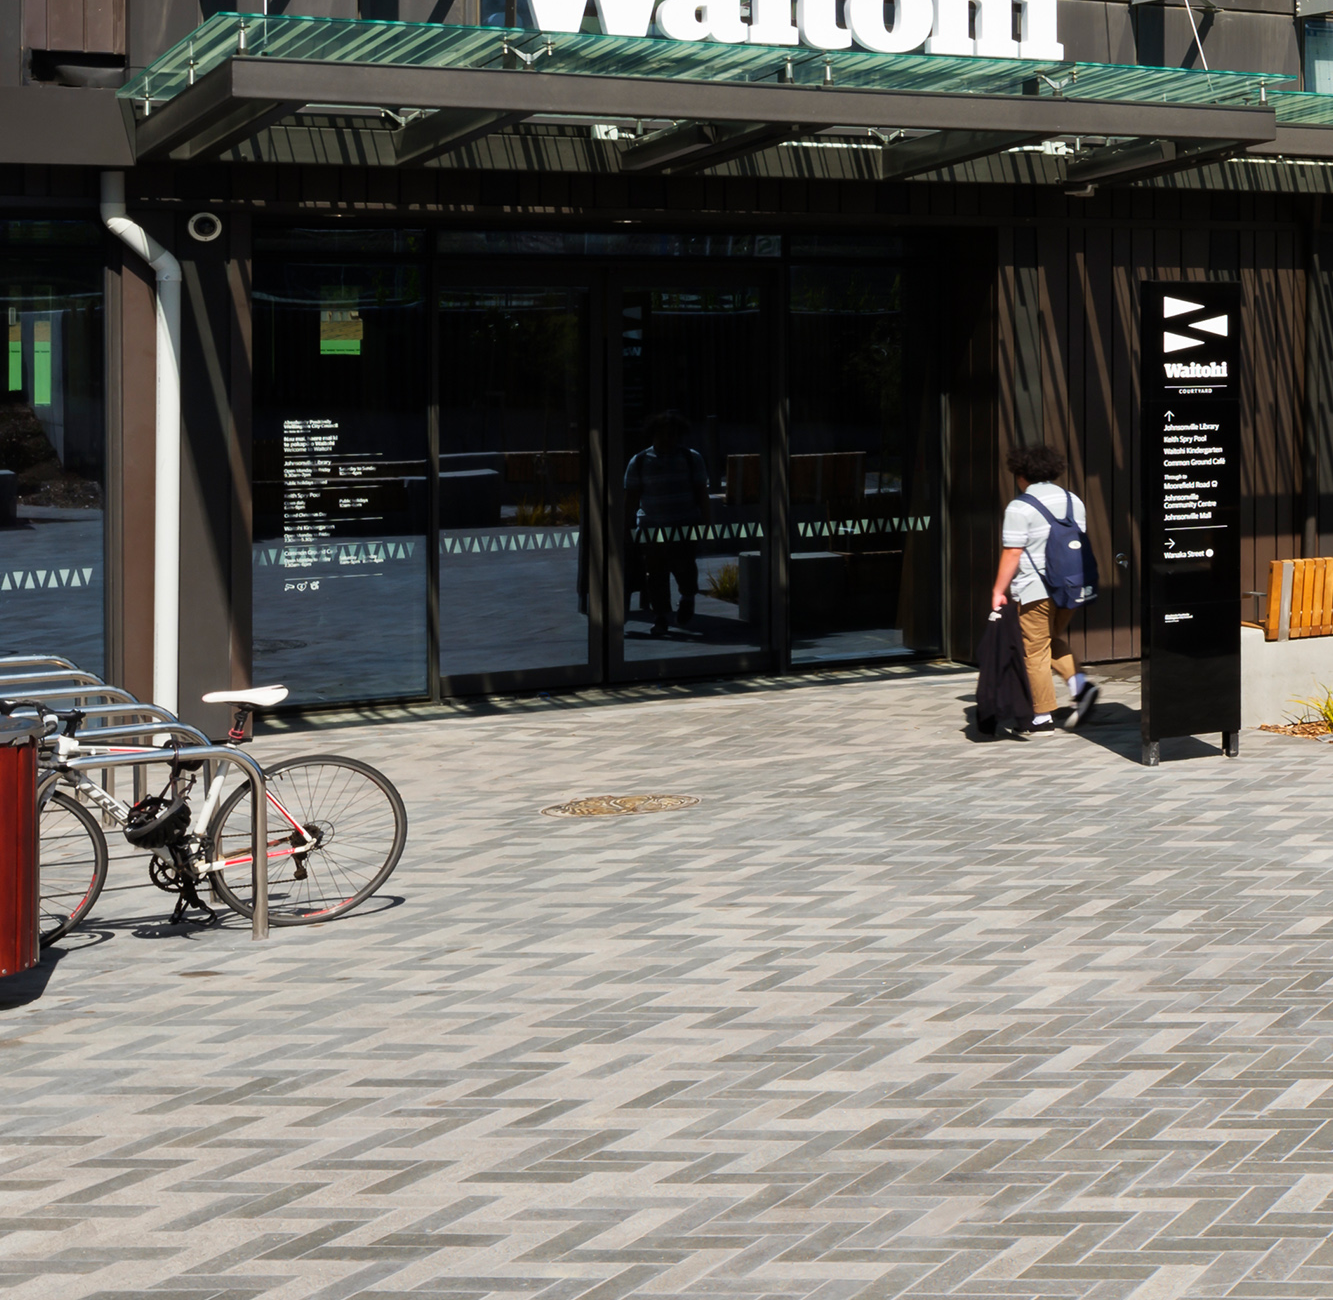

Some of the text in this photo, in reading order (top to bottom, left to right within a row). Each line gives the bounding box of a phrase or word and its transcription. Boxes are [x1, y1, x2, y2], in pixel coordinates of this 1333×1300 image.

[1164, 362, 1228, 378] Waitohi
[1164, 423, 1219, 431] Johnsonville Library
[1179, 435, 1193, 443] Spry
[1187, 447, 1223, 455] Kindergarten
[1191, 458, 1212, 466] Ground
[1164, 493, 1199, 501] Johnsonville
[1164, 501, 1197, 509] Community
[1164, 512, 1198, 521] Johnsonville
[81, 781, 129, 824] TRE
